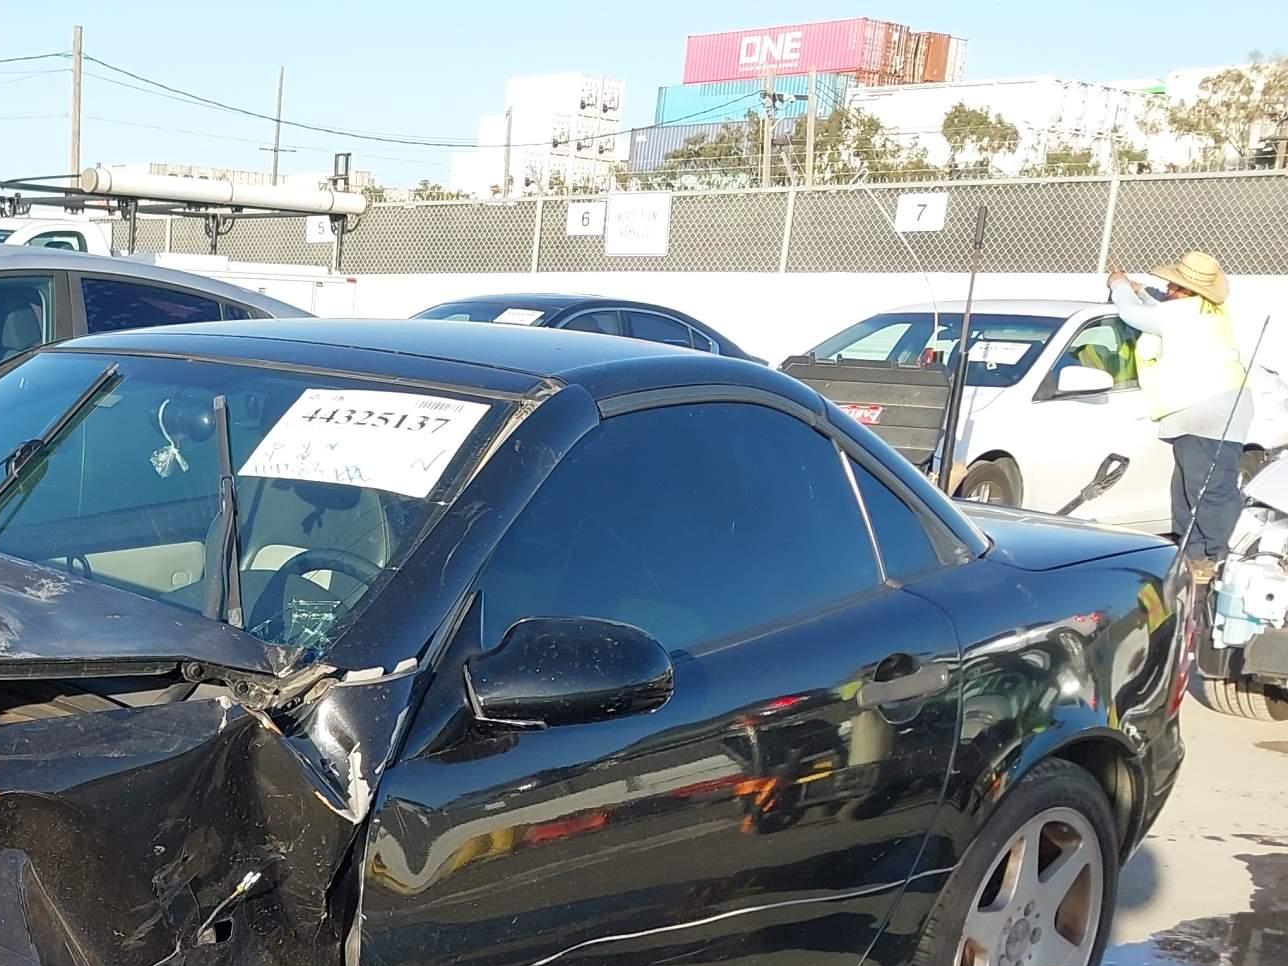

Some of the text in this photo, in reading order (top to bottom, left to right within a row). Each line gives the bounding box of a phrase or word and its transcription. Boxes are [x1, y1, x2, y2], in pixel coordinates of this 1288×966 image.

[739, 31, 803, 64] ONE
[580, 211, 591, 227] 6
[916, 203, 928, 222] 7
[317, 221, 325, 235] 5
[302, 407, 452, 434] 44325137
